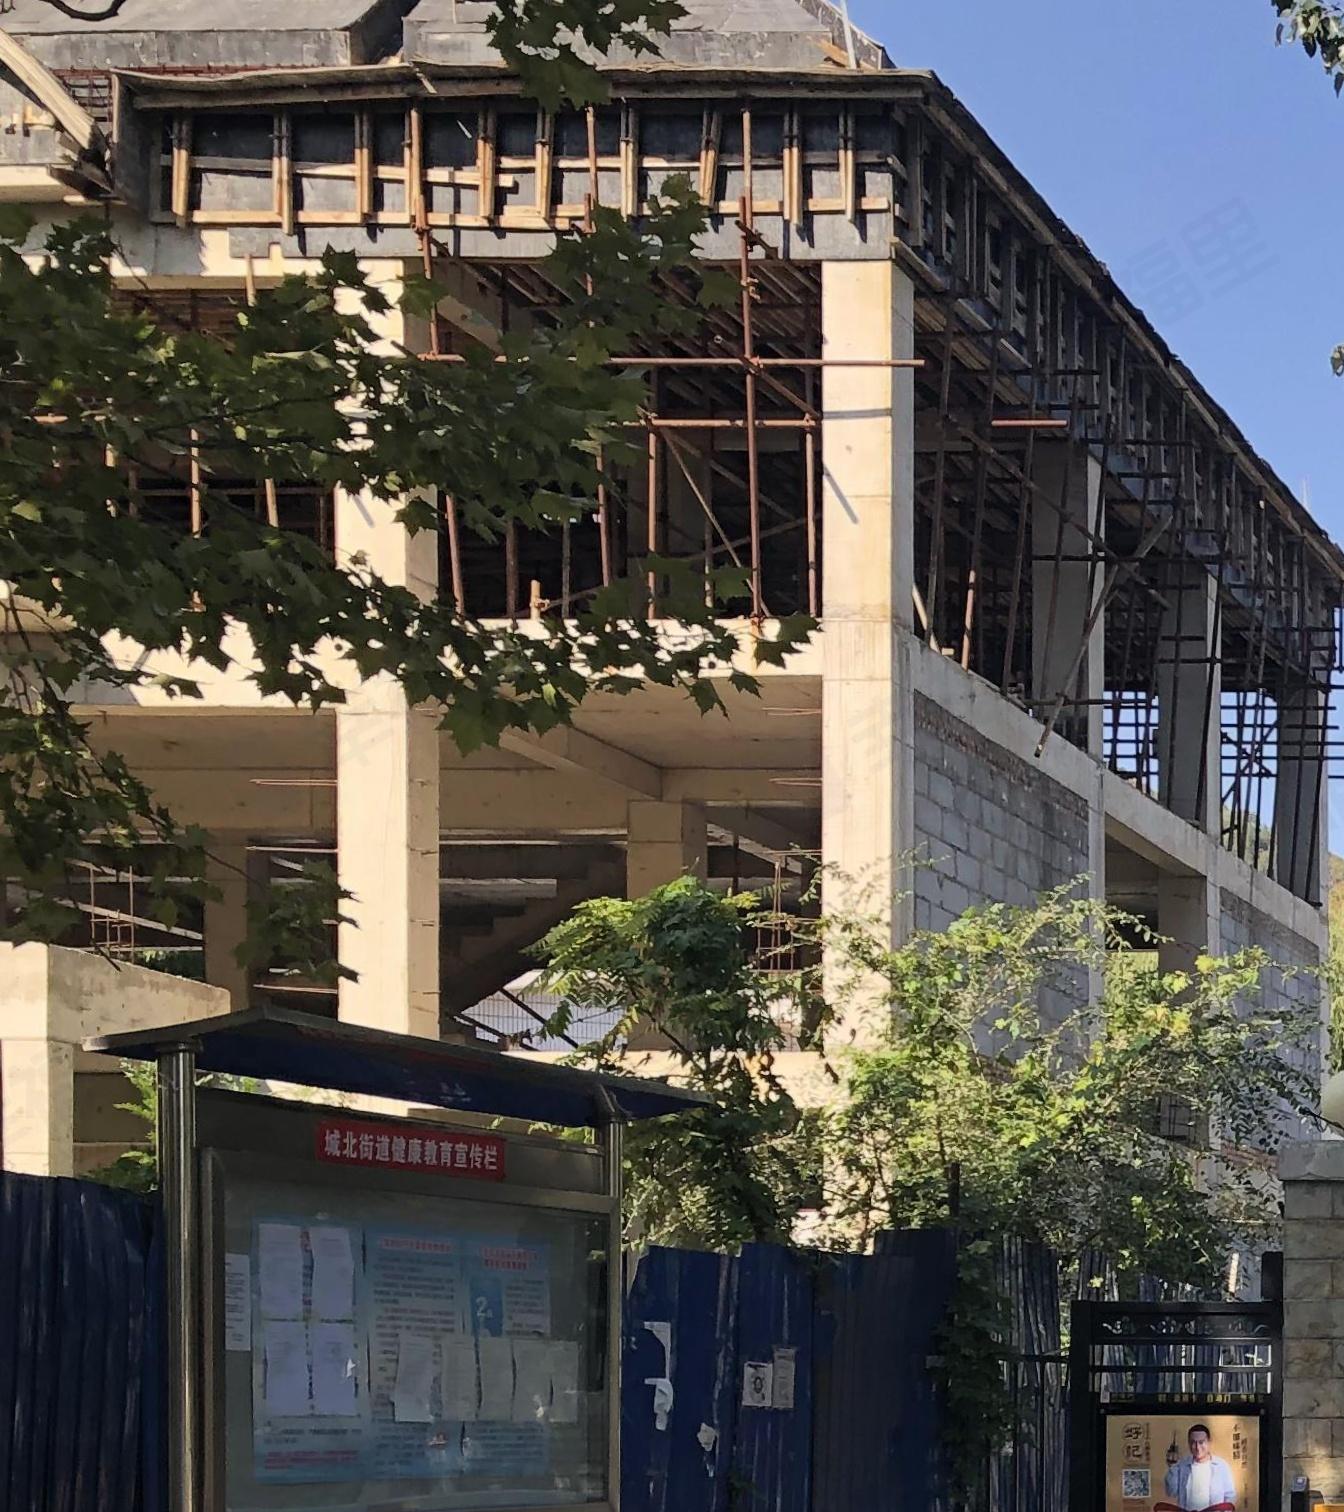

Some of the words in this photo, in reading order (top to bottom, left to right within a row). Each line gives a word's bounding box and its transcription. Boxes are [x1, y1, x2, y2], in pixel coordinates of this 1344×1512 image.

[324, 1128, 498, 1172] 城北街道健康教育宣传栏
